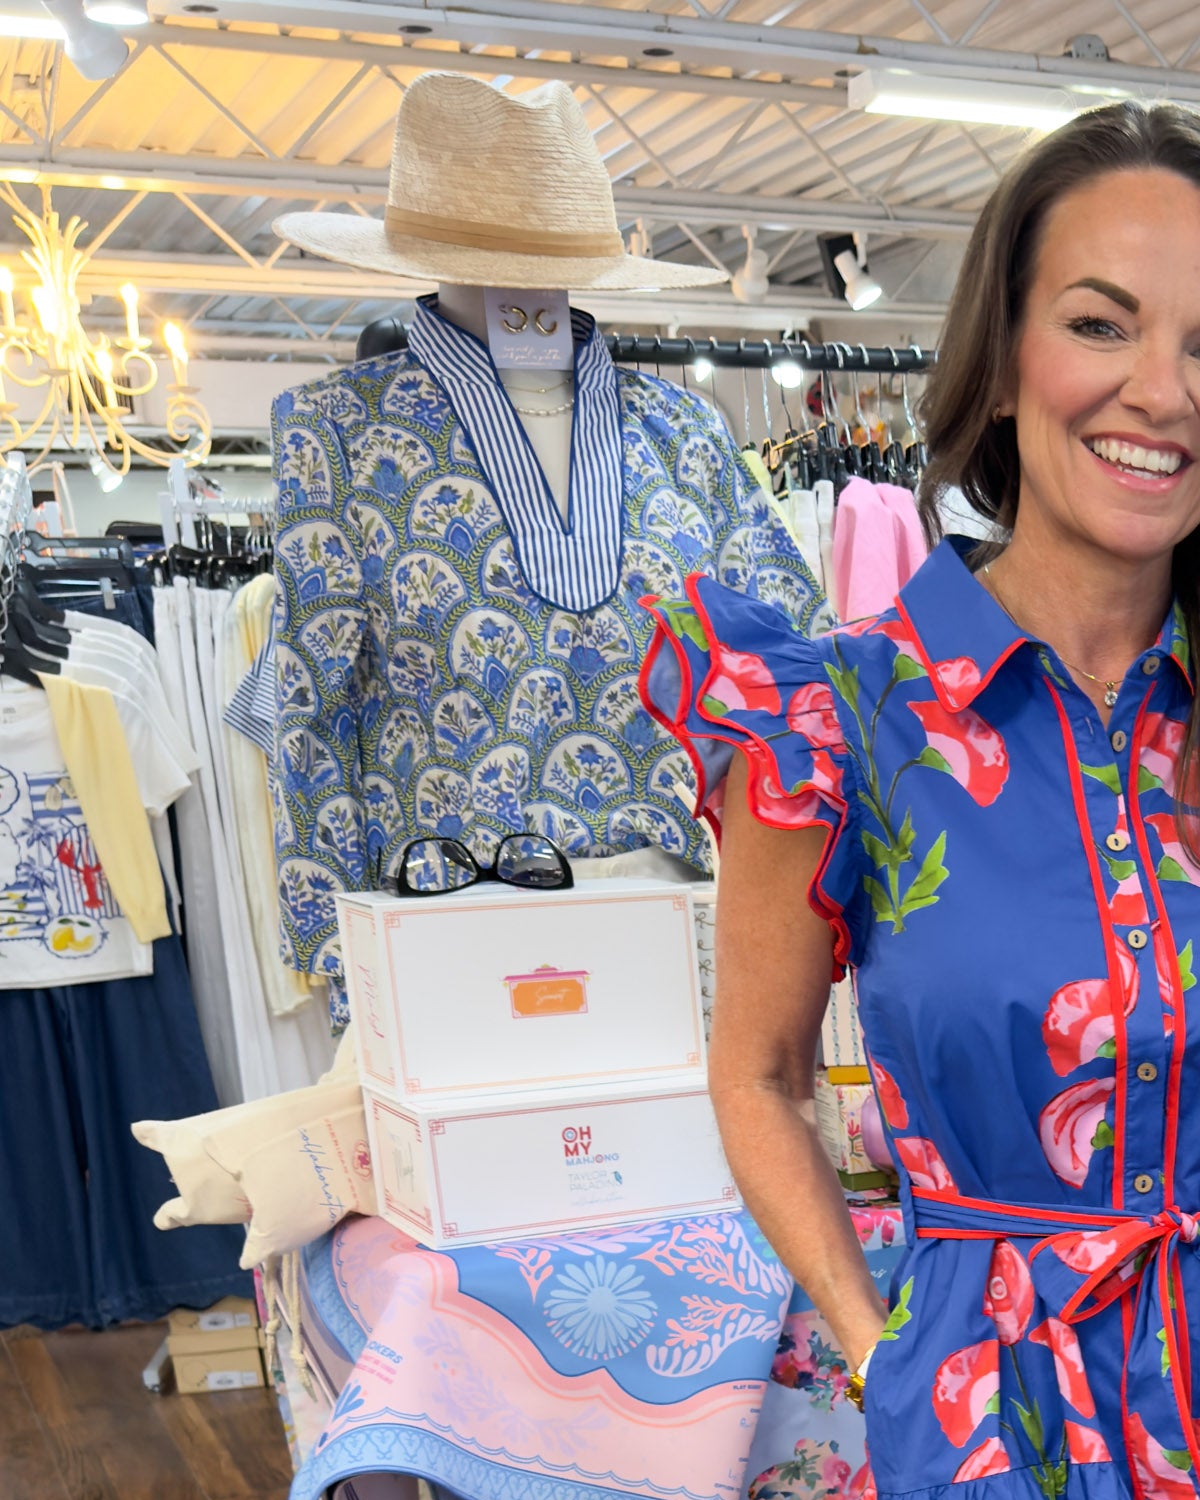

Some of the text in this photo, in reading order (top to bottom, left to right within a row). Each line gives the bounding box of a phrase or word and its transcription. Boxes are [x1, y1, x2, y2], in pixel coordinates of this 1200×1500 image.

[561, 1125, 592, 1143] OH
[563, 1141, 592, 1157] MY
[565, 1153, 620, 1166] MAHJONG
[367, 1341, 403, 1364] OKERS
